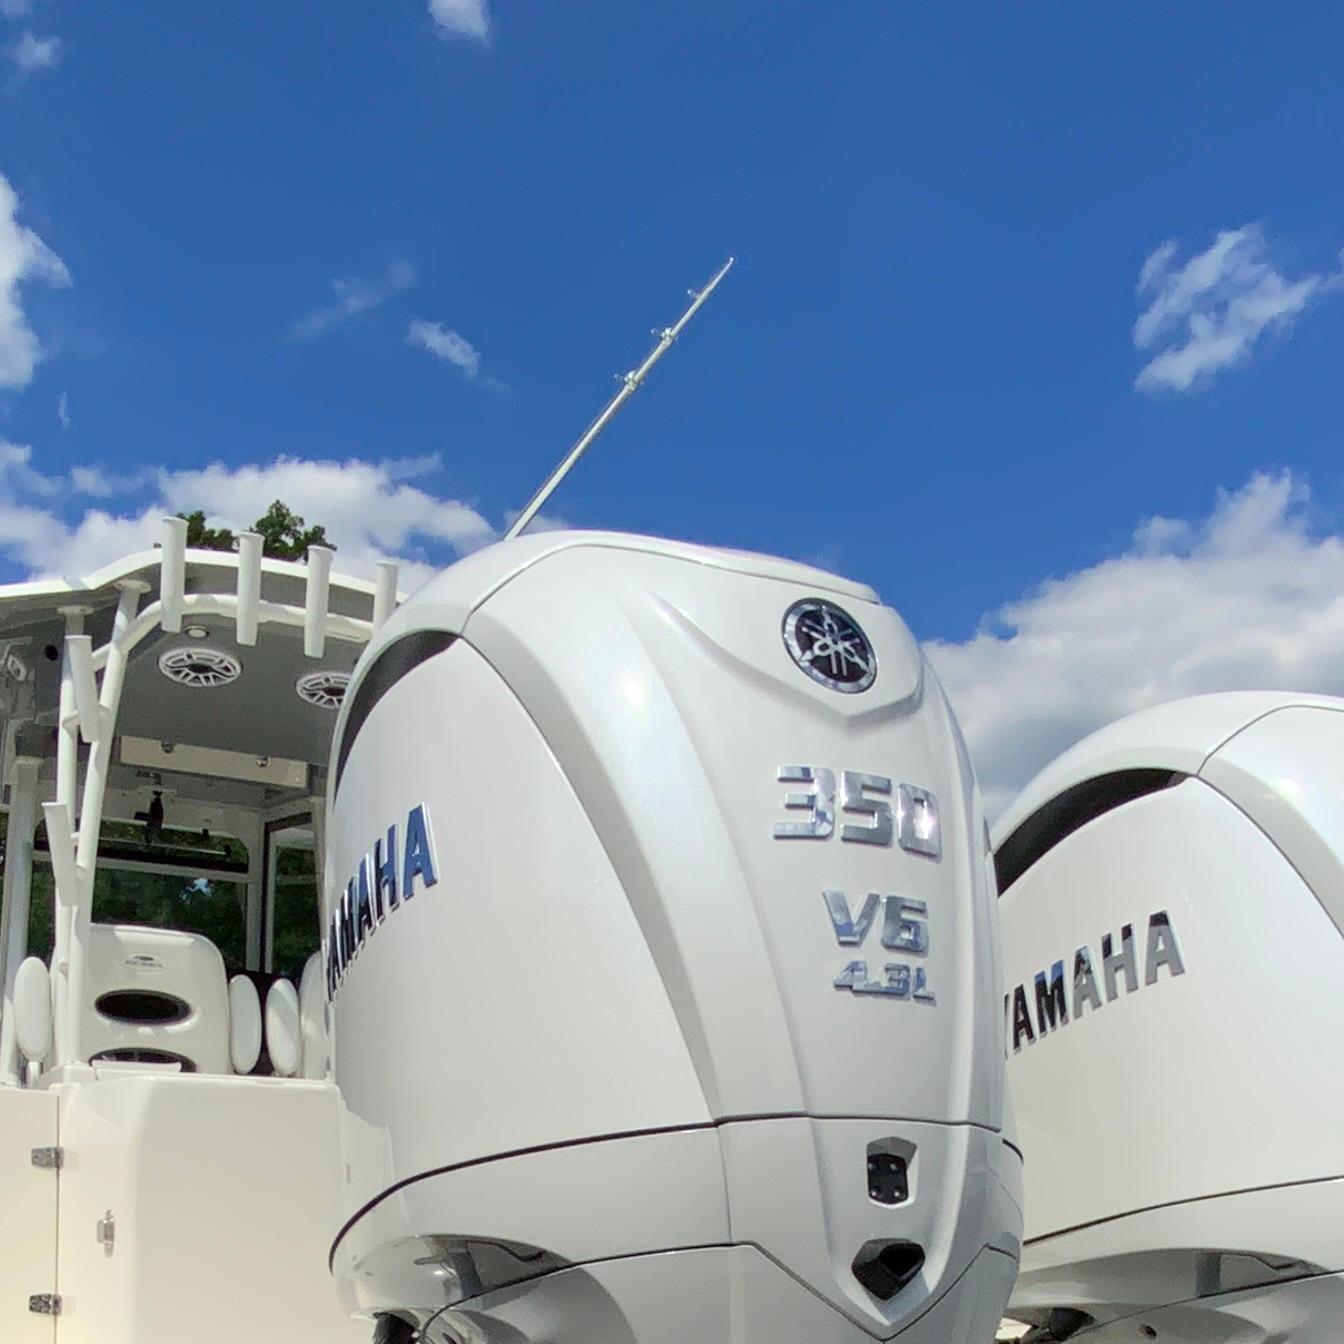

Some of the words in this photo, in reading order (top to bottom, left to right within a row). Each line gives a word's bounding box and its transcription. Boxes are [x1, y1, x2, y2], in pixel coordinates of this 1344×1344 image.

[773, 766, 942, 861] 350
[326, 802, 440, 1002] AMAHA
[823, 890, 930, 955] V6
